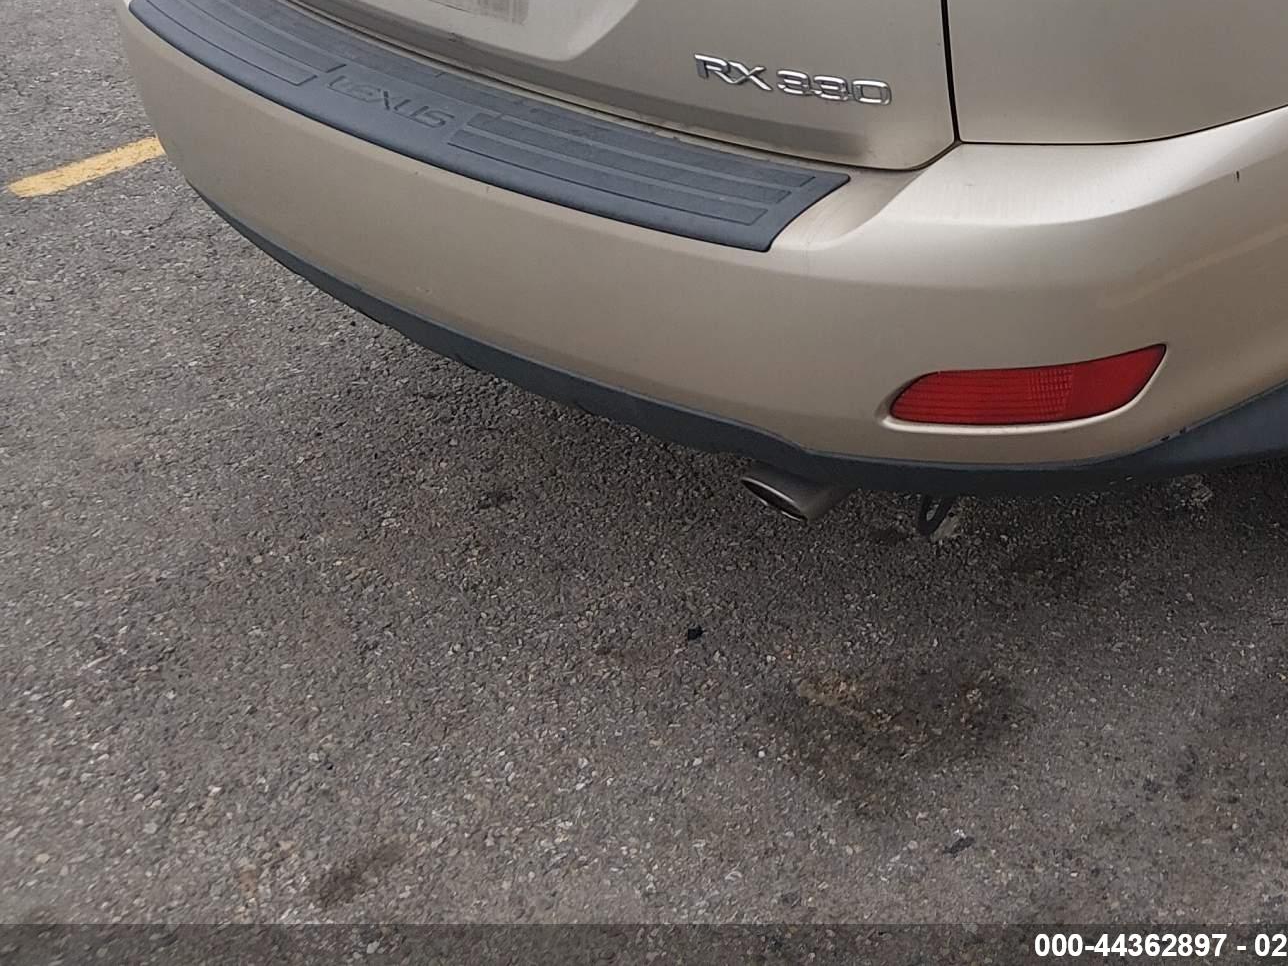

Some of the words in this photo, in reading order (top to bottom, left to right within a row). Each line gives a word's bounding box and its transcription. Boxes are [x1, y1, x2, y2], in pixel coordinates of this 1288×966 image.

[327, 75, 455, 128] LEXUS
[694, 53, 774, 91] RX
[776, 69, 892, 106] 330
